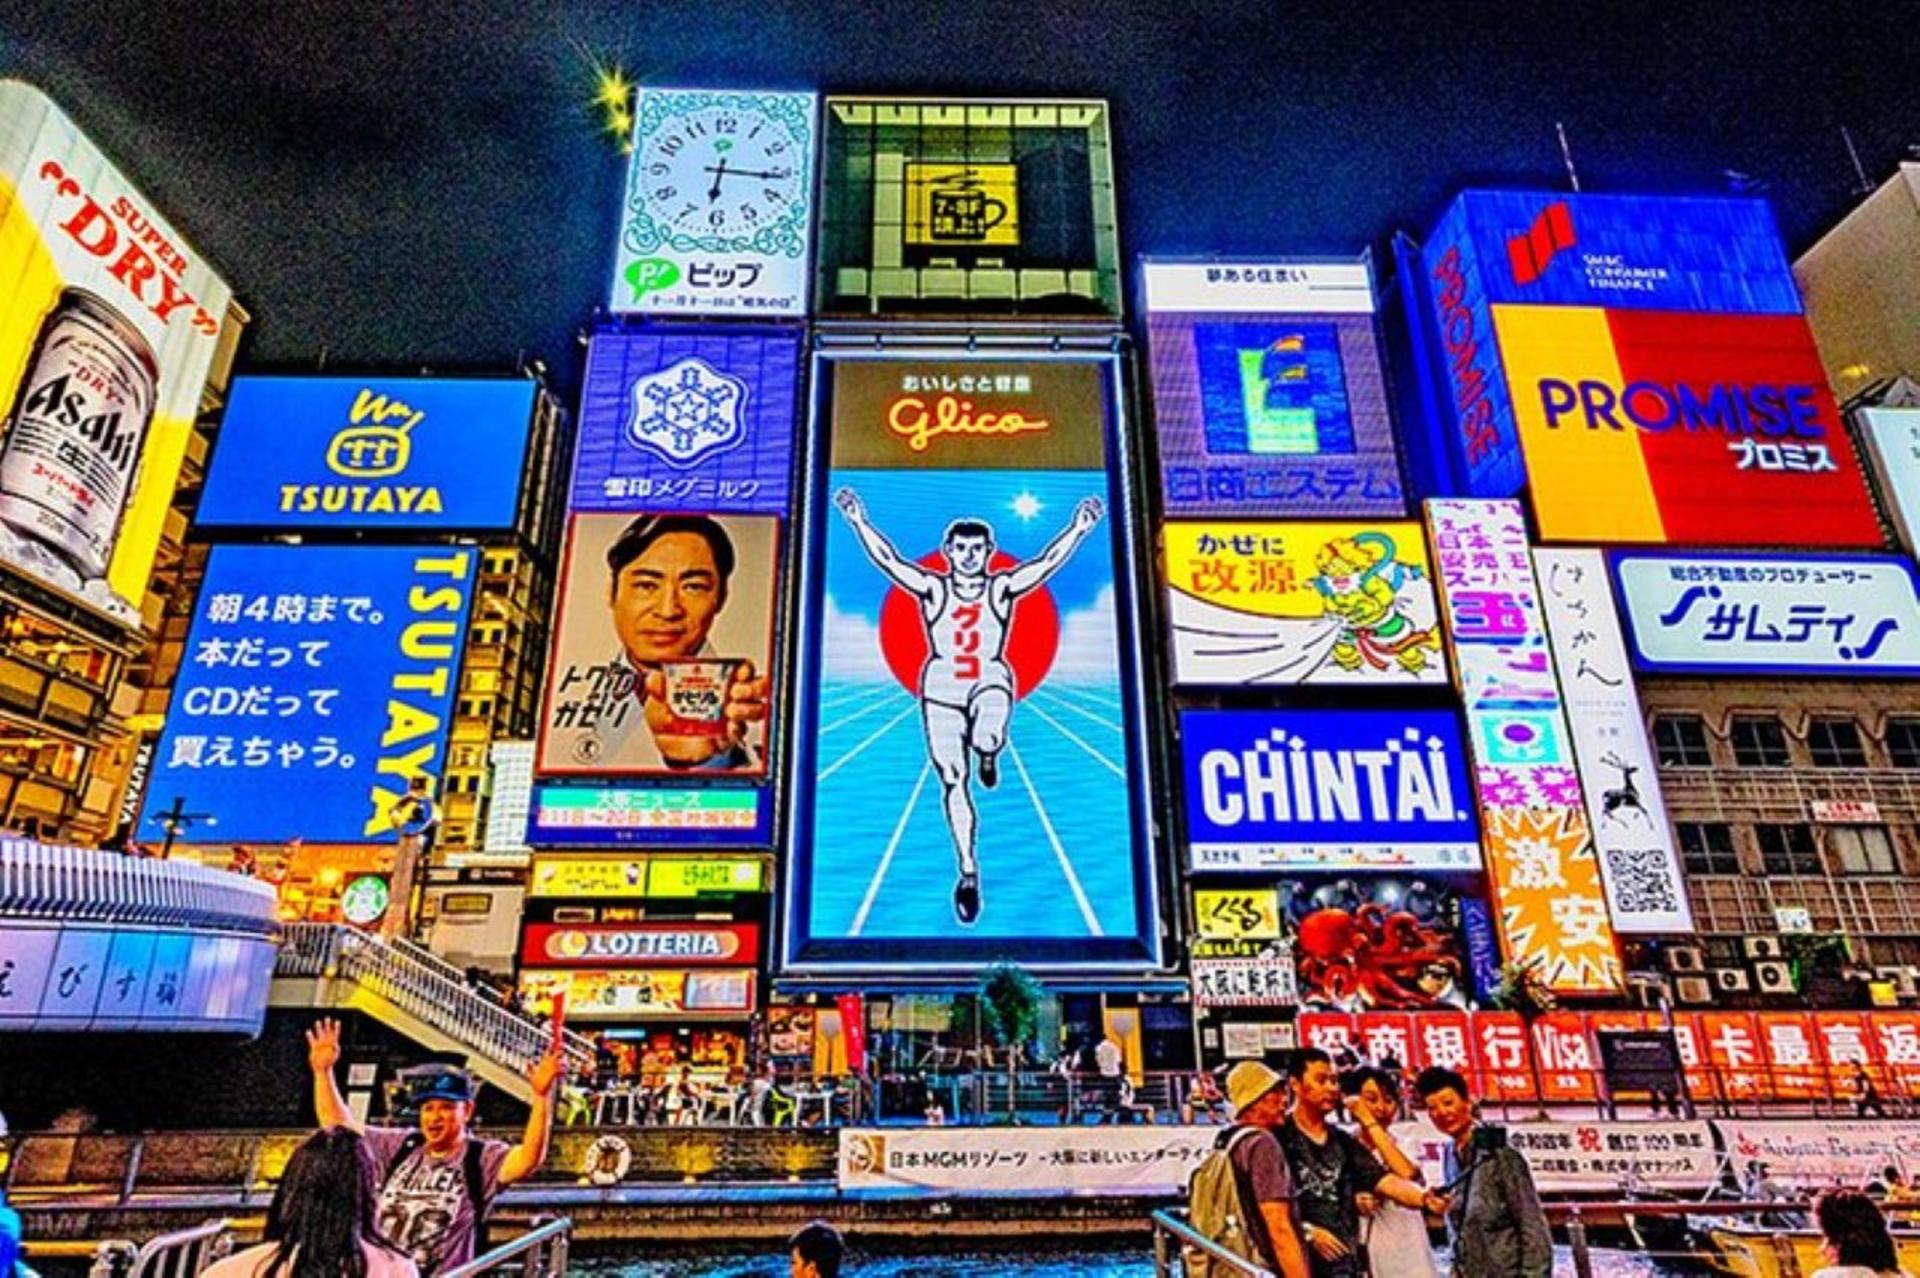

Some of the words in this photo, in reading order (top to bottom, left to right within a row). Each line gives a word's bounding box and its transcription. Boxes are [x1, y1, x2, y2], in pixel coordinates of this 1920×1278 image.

[714, 118, 738, 134] 12
[659, 134, 685, 157] 10
[650, 161, 671, 177] 9
[655, 184, 678, 201] 8
[708, 209, 726, 227] 6
[111, 195, 190, 277] SUPER
[686, 262, 763, 289] ピップ
[1434, 246, 1500, 468] PROMISE
[25, 373, 137, 472] Asahi
[888, 396, 1049, 451] Glico
[1538, 377, 1826, 438] PROMISE
[1728, 440, 1839, 472] プロミス
[1167, 465, 1398, 501] 日商エステム
[280, 486, 444, 514] TSUTAYA
[1198, 533, 1286, 556] かぜに
[1188, 559, 1297, 595] 改源
[1703, 604, 1855, 643] サムティ
[194, 638, 330, 668] 本だって
[950, 602, 982, 681] グリコ
[182, 687, 340, 717] CDだって
[363, 551, 471, 838] TSUTAYA
[166, 735, 357, 769] 買えちゃう。
[1506, 836, 1611, 949] 激安
[592, 933, 722, 954] LOTTERIA
[1532, 1023, 1592, 1070] Visa
[1577, 1127, 1602, 1152] 祝
[889, 1149, 1029, 1169] 日本MGMリゾーツ
